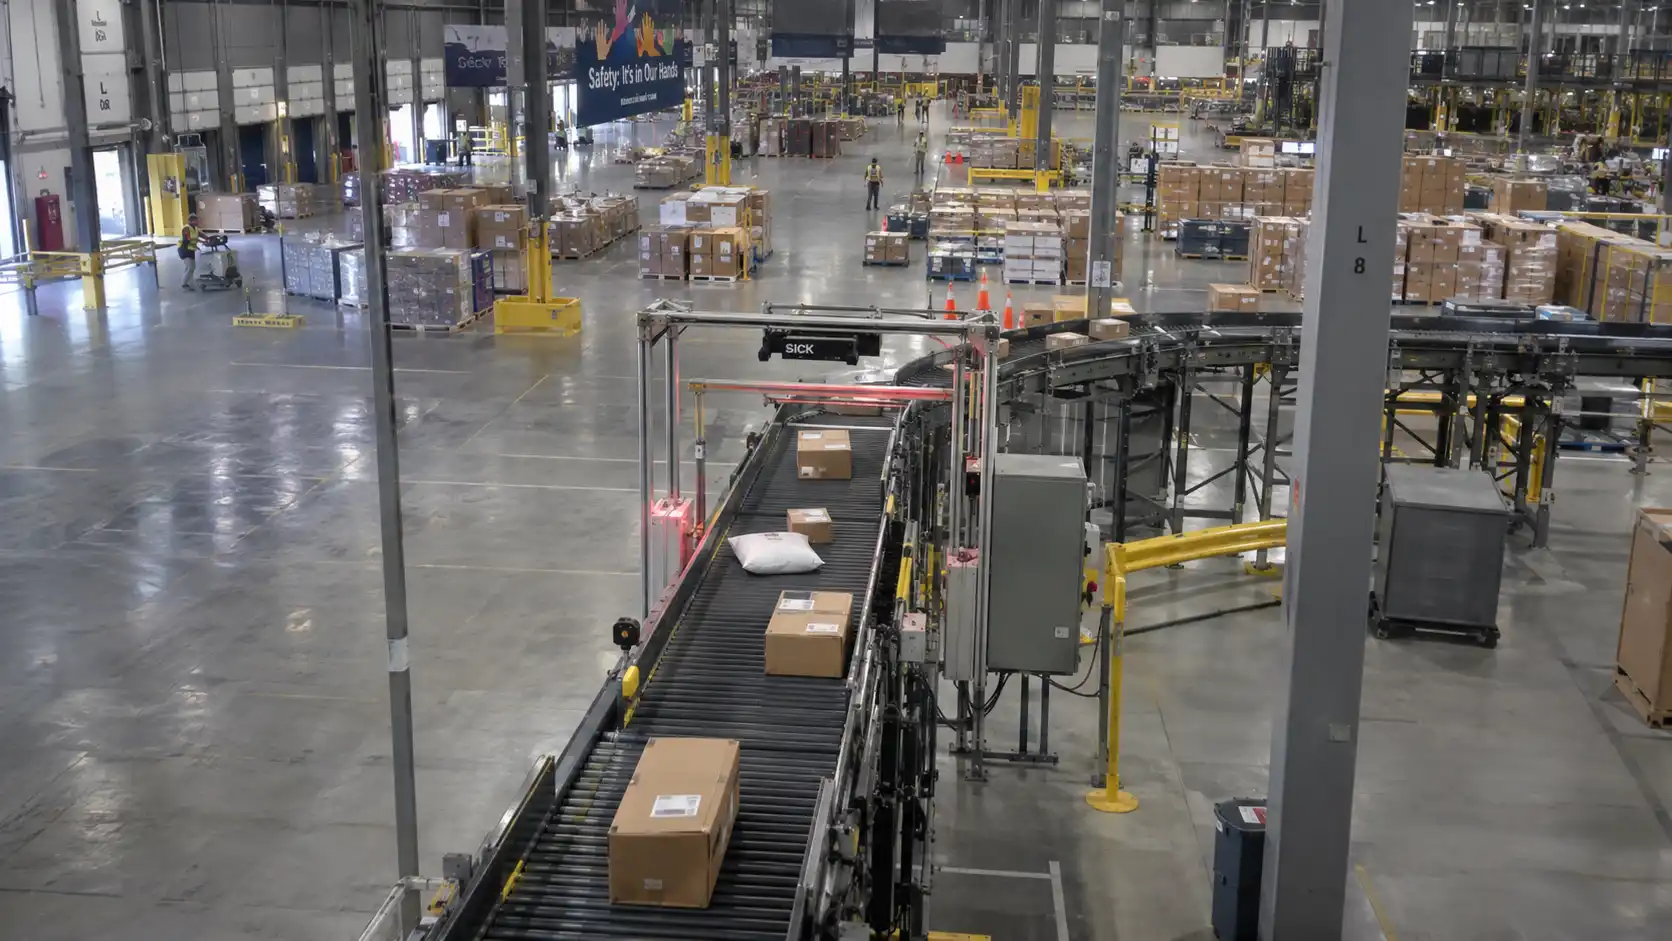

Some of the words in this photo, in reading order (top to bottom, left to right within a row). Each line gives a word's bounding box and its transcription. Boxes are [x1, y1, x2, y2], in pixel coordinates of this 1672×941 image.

[589, 66, 620, 91] Safety:
[622, 64, 633, 85] It's
[635, 64, 643, 84] in
[644, 62, 657, 82] Our
[658, 60, 679, 80] Hands
[1357, 225, 1367, 243] L
[1354, 256, 1365, 274] 8
[785, 343, 814, 355] SICK
